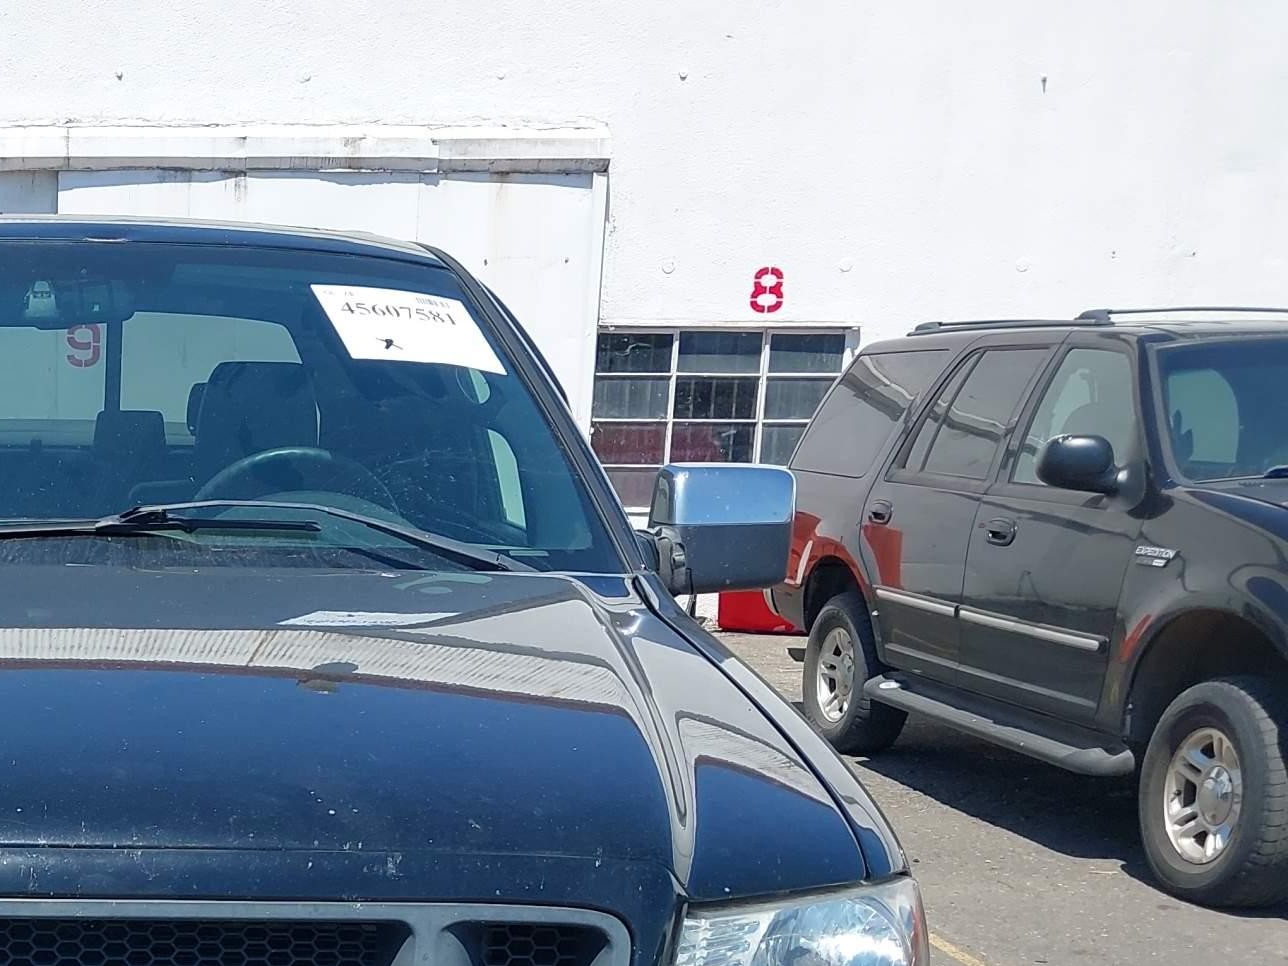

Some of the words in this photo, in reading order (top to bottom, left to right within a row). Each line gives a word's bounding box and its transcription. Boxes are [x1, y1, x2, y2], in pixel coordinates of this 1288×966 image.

[750, 266, 783, 313] 8
[341, 301, 456, 325] 45607581
[66, 324, 101, 368] 9
